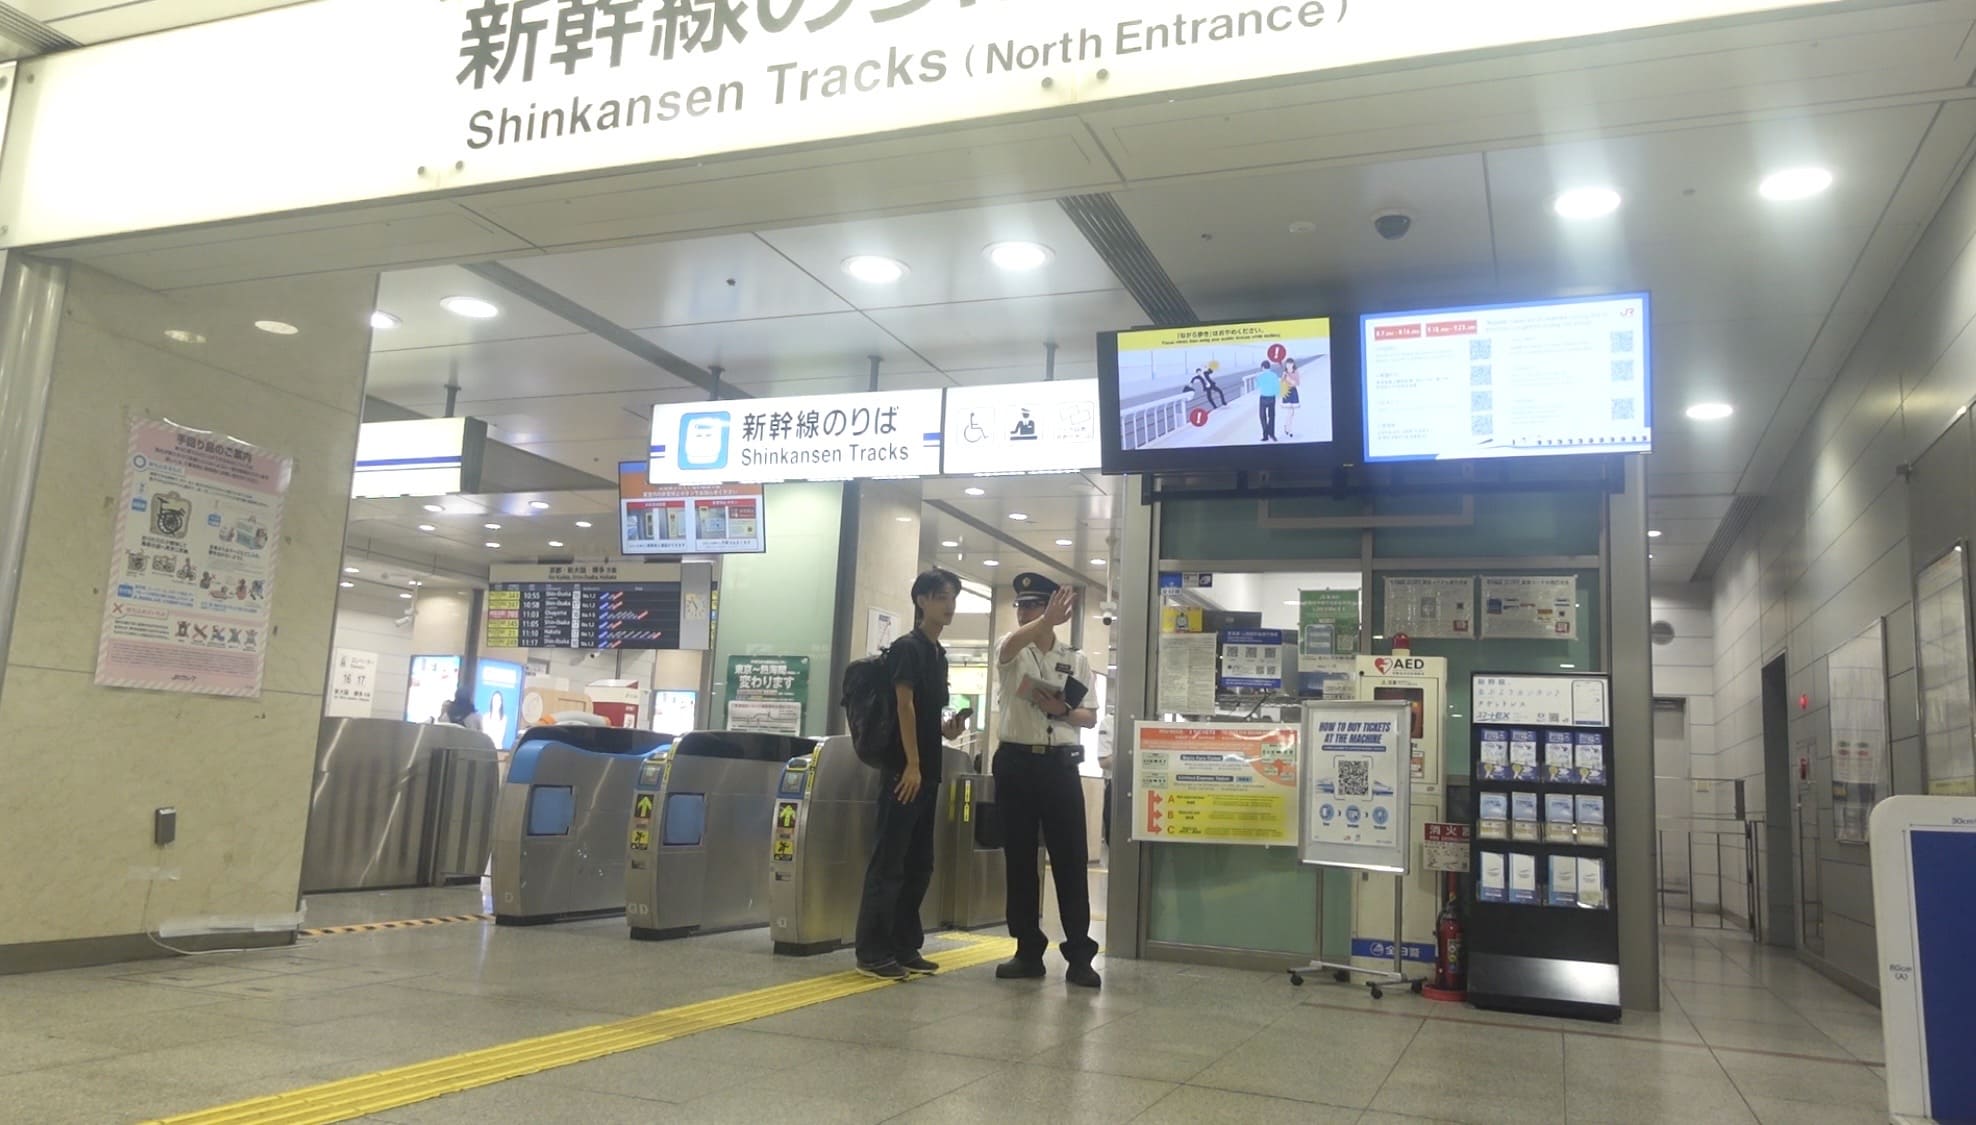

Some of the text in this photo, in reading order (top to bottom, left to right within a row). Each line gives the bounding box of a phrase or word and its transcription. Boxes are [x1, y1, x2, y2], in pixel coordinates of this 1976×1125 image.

[465, 77, 745, 150] Shinkansen
[766, 44, 948, 107] Tracks
[965, 32, 1101, 78] (North
[742, 406, 900, 442] 新幹線のりば
[176, 433, 253, 463] 手回り品のご案内
[741, 443, 909, 466] Shinkansen Tracks
[1394, 658, 1424, 670] AED
[739, 675, 795, 689] 変わります
[1318, 722, 1391, 732] HOW TO BUY TICKETS
[1324, 734, 1382, 744] AT THE MACHINE
[1167, 795, 1176, 804] A
[1167, 811, 1174, 820] B
[1166, 825, 1175, 834] C
